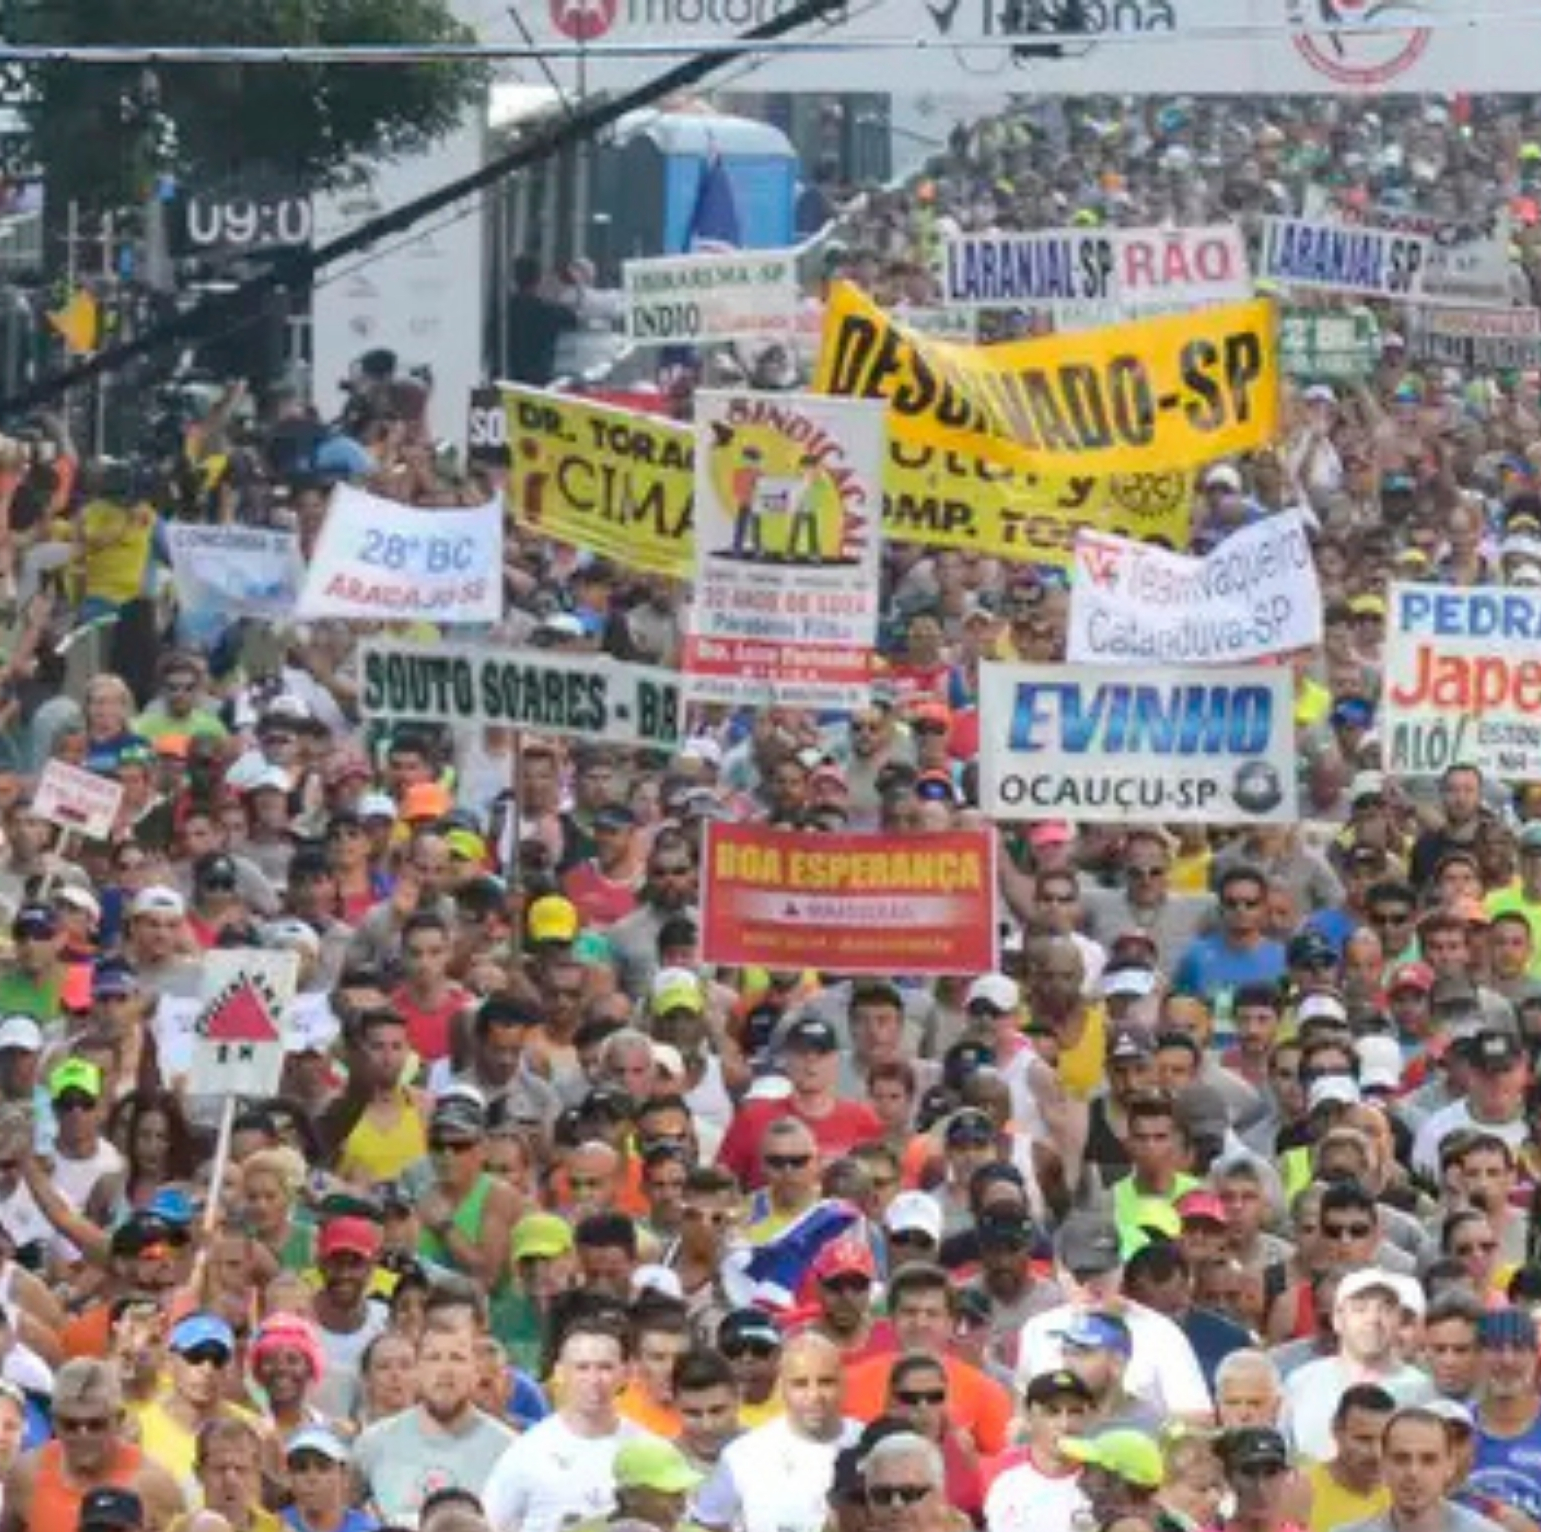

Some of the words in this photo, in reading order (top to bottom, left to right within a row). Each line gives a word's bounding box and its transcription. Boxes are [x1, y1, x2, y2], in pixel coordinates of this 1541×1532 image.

[426, 535, 473, 573] BC
[364, 650, 472, 710] SOUTO
[480, 660, 606, 731] SOARES
[636, 682, 680, 740] BA
[999, 771, 1218, 815] OCAUÇU-SP
[789, 850, 981, 890] ESPERANÇA
